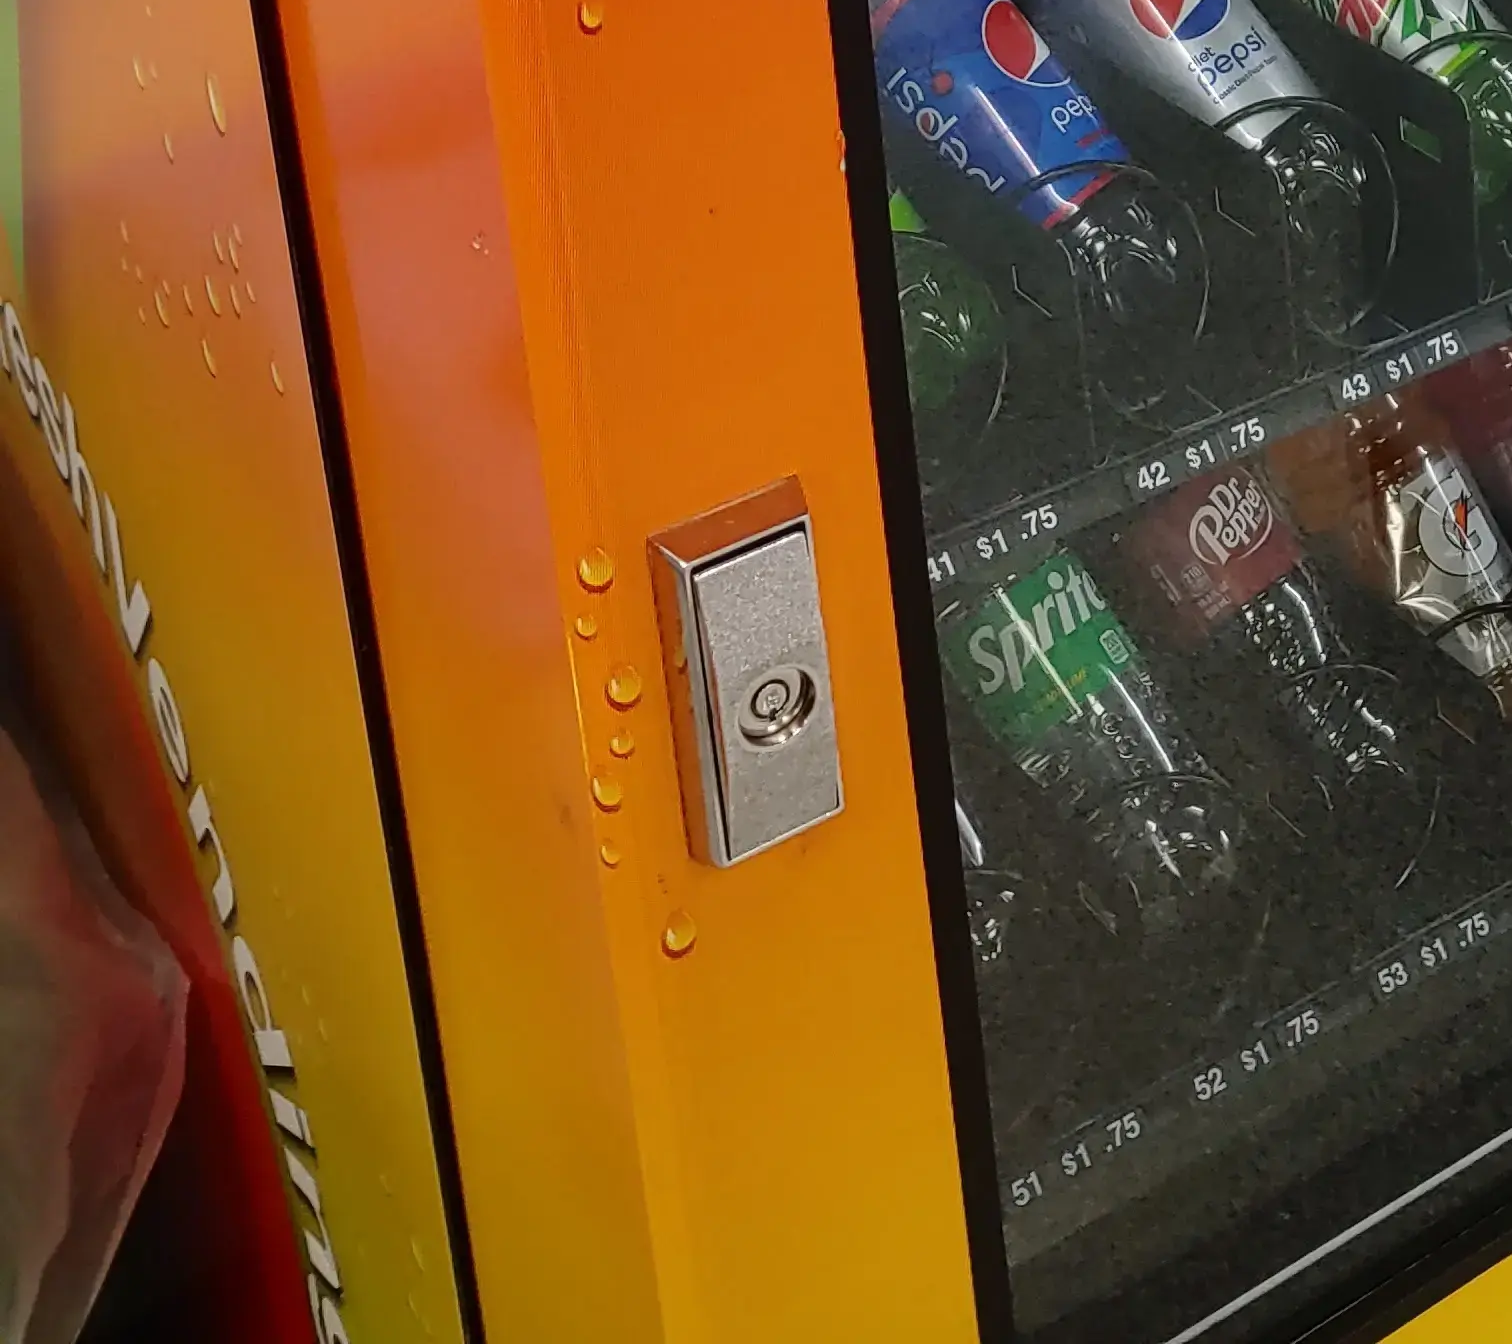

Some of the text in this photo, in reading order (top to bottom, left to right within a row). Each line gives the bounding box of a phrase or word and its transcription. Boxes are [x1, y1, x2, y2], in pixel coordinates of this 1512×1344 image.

[1197, 24, 1267, 97] pepsi
[1341, 331, 1460, 400] 43 $1 .75
[1137, 417, 1266, 492] 42 $1 .75
[1189, 478, 1266, 566] Pepper
[1208, 477, 1244, 514] Dr
[925, 505, 1059, 583] 41 $1 .75
[968, 564, 1107, 696] Sprite
[1377, 913, 1490, 995] 53 $1 .75
[1193, 1009, 1321, 1102] 52 $1 .75
[1011, 1112, 1142, 1208] 51 $1 .75
